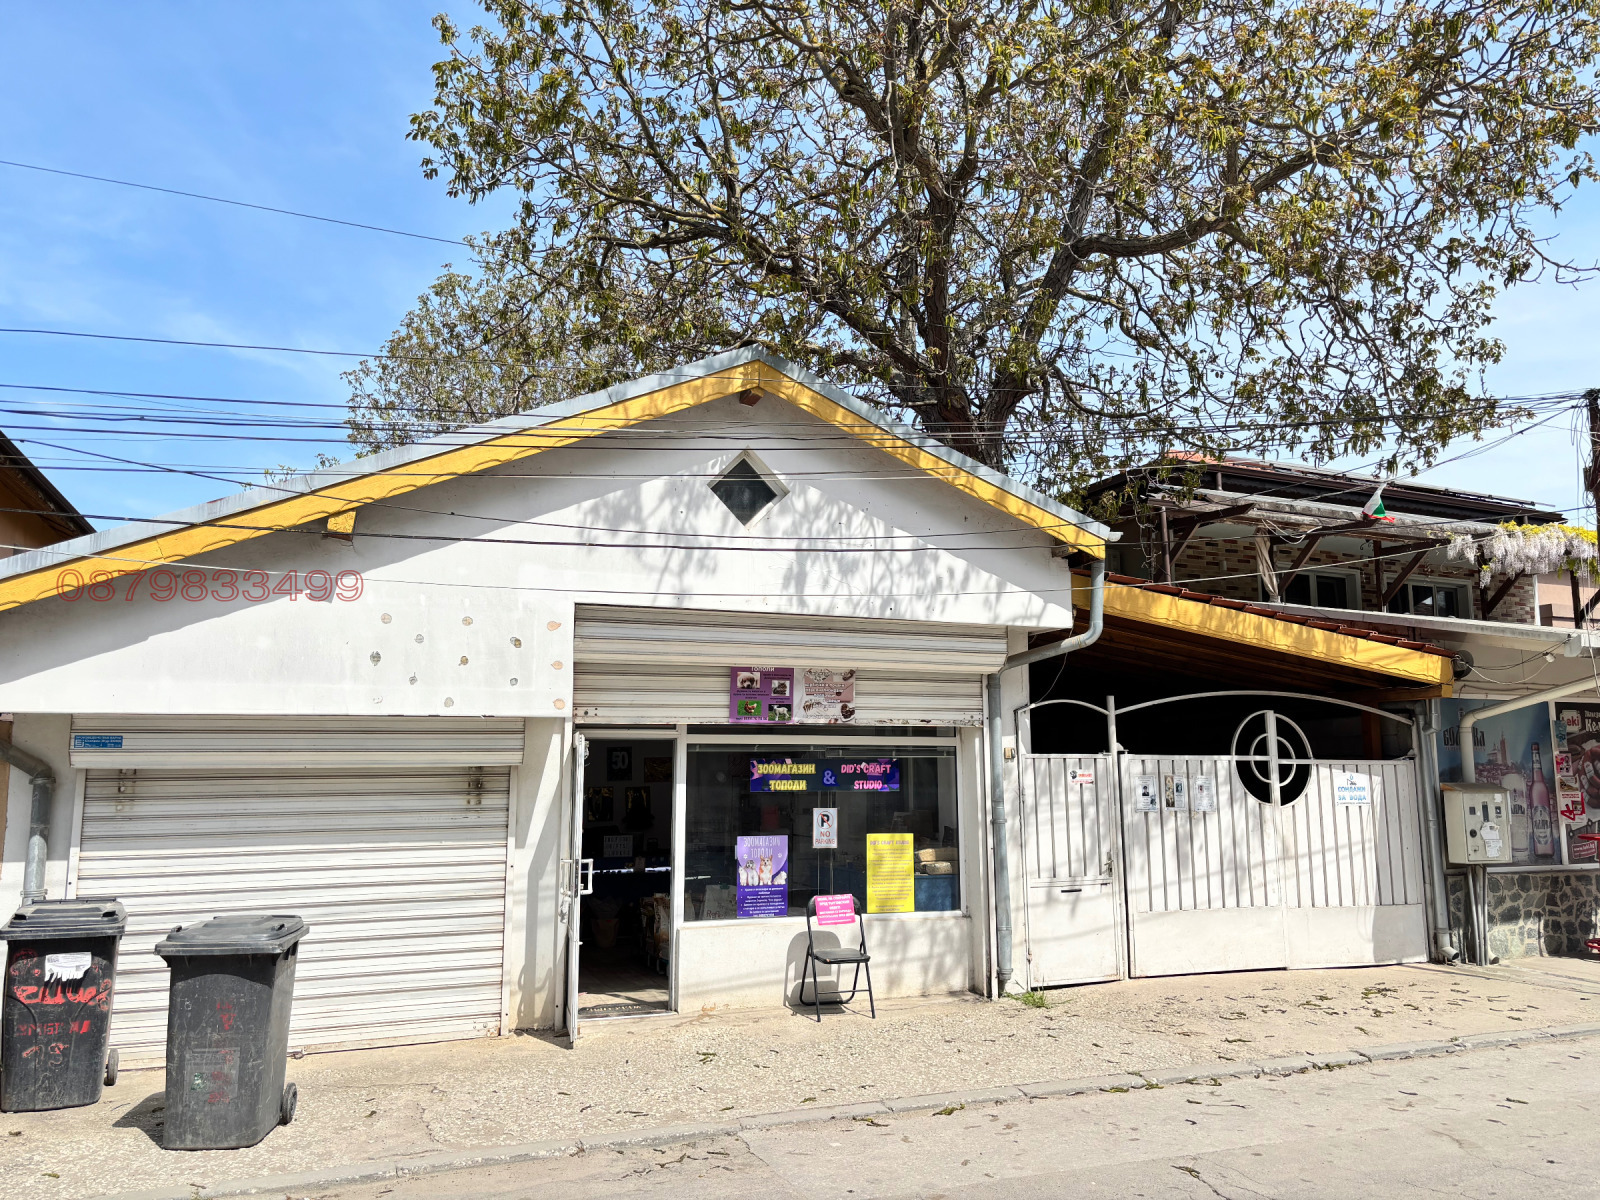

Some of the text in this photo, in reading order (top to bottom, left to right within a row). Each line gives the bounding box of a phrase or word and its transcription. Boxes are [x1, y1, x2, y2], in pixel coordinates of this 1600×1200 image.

[757, 763, 816, 775] ЗООМАГАЗИН
[841, 763, 892, 774] DID'S CRAFT
[823, 770, 836, 785] &
[769, 780, 807, 791] ТОПОЛИ
[854, 780, 883, 790] STUDIO
